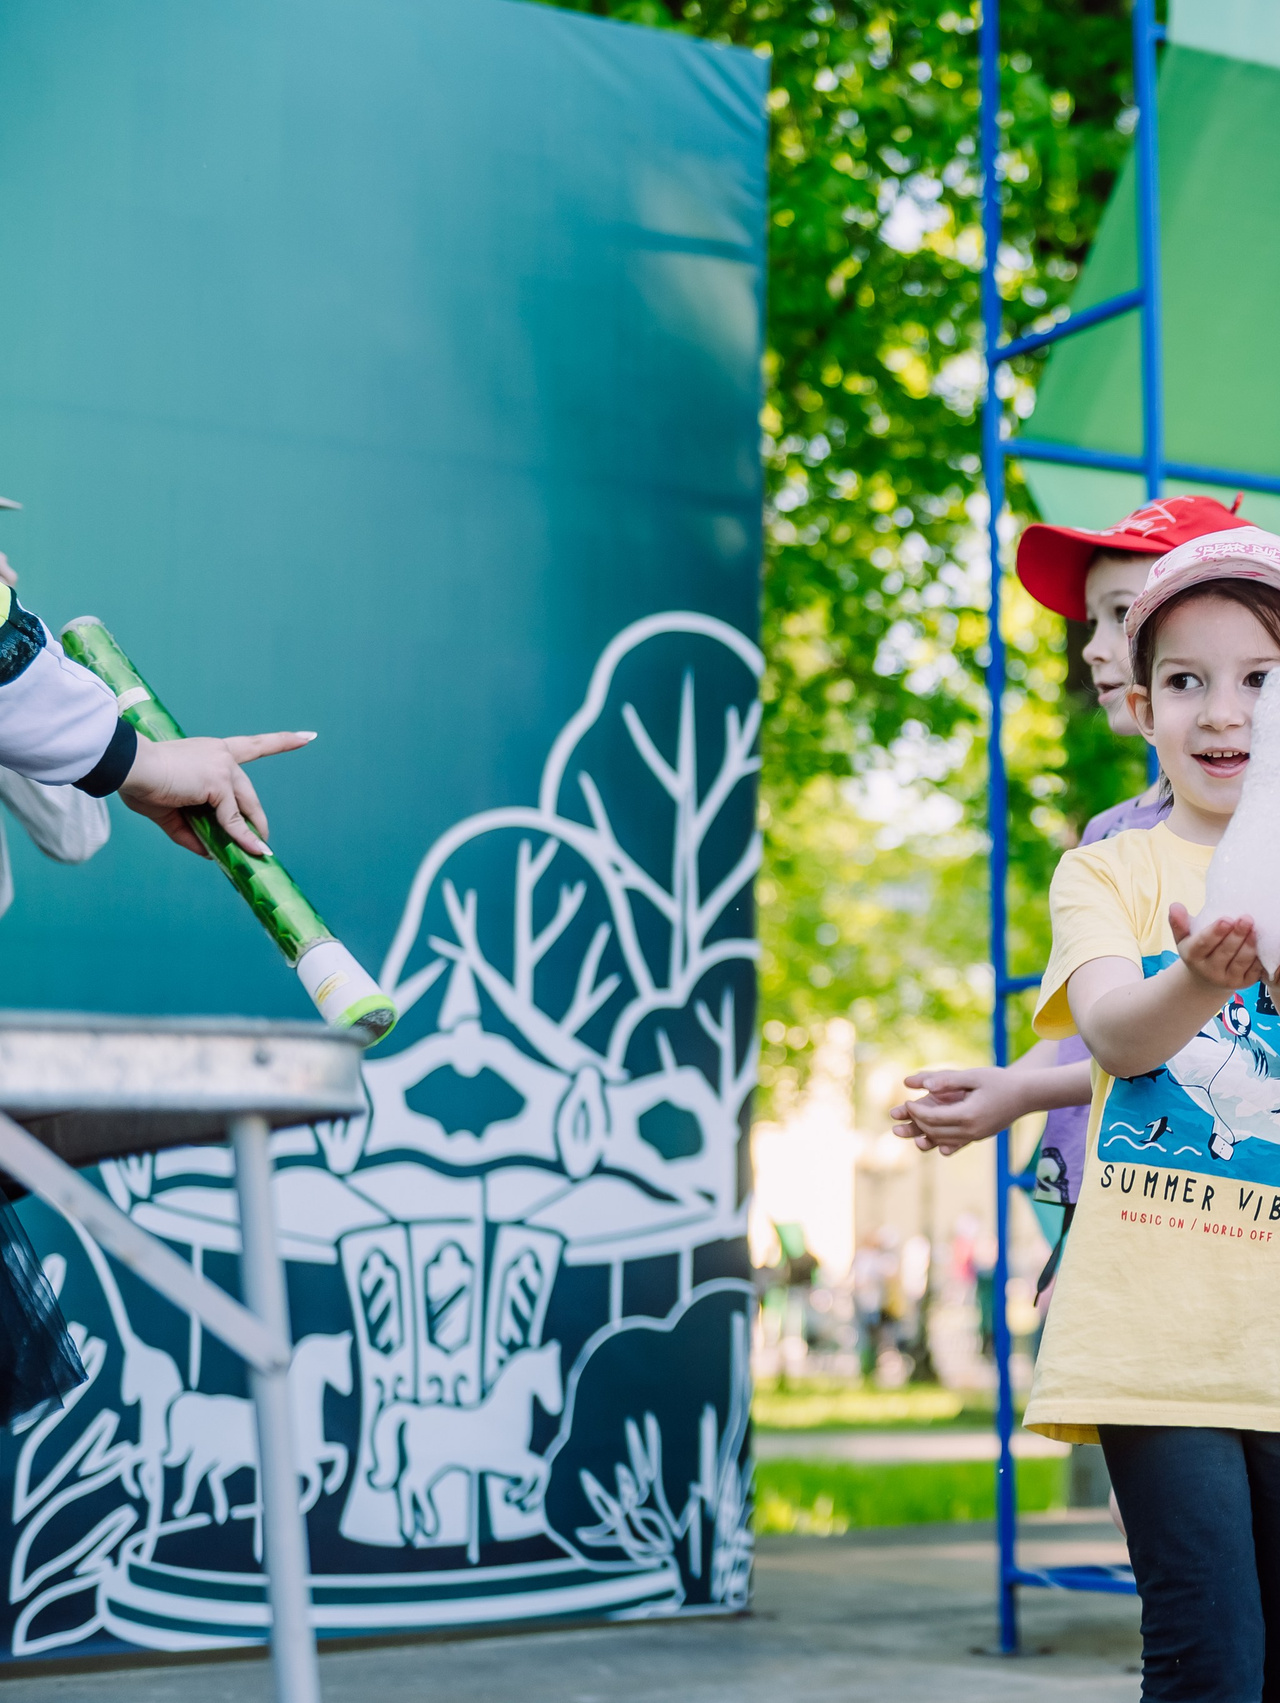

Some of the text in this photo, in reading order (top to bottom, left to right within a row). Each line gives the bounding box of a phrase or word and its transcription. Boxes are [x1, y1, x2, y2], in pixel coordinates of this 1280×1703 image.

[1100, 1164, 1215, 1212] SUMMER
[1121, 1209, 1163, 1226] MUSIC
[1169, 1216, 1185, 1229] ON
[1203, 1222, 1243, 1239] WORLD
[1249, 1229, 1274, 1243] OFF
